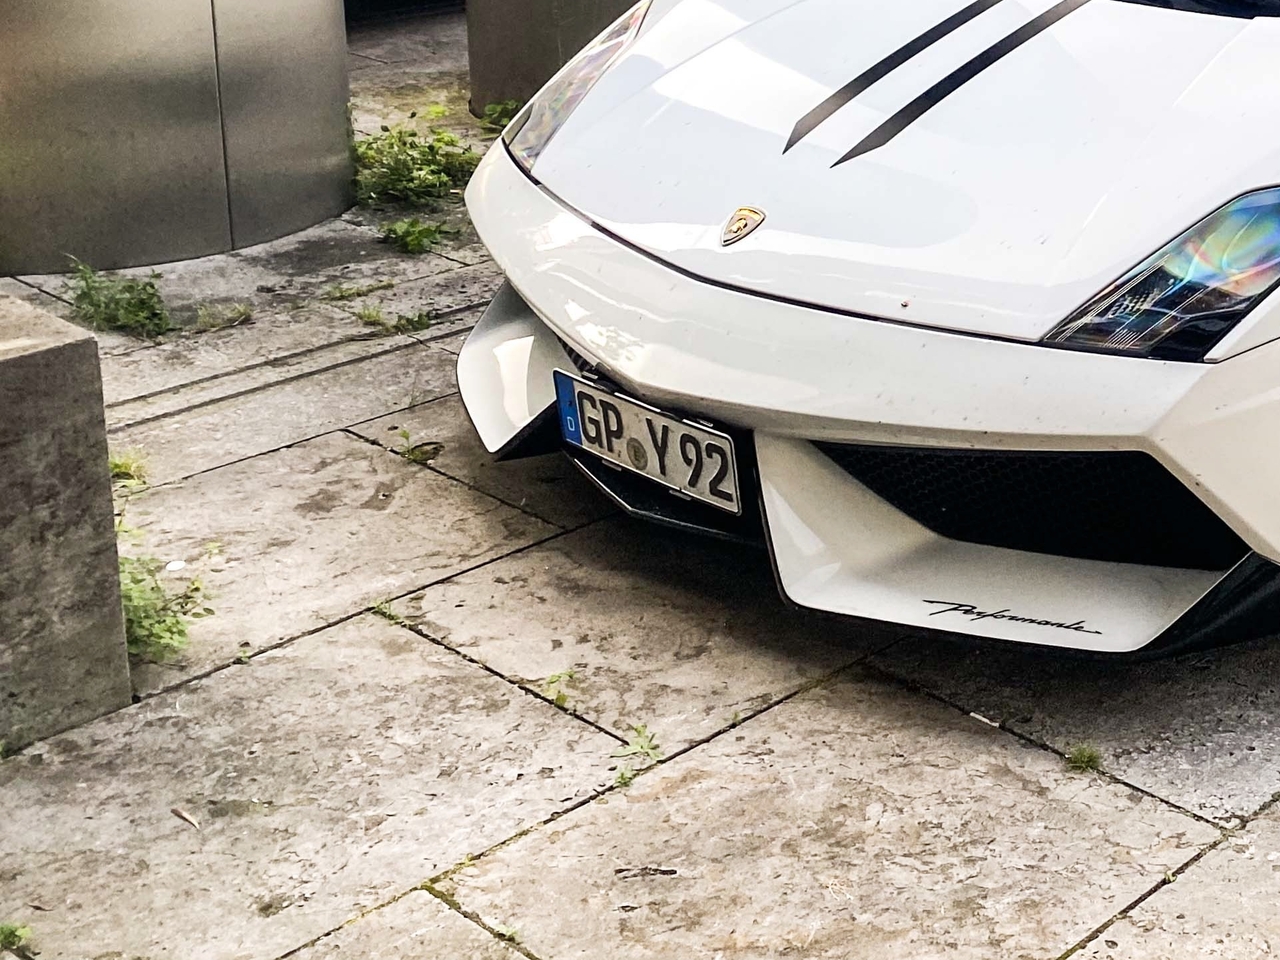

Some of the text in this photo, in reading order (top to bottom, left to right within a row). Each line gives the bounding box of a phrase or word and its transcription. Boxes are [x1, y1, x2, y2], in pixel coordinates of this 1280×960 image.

[576, 390, 734, 504] GP Y 92
[922, 599, 1103, 635] Performante
